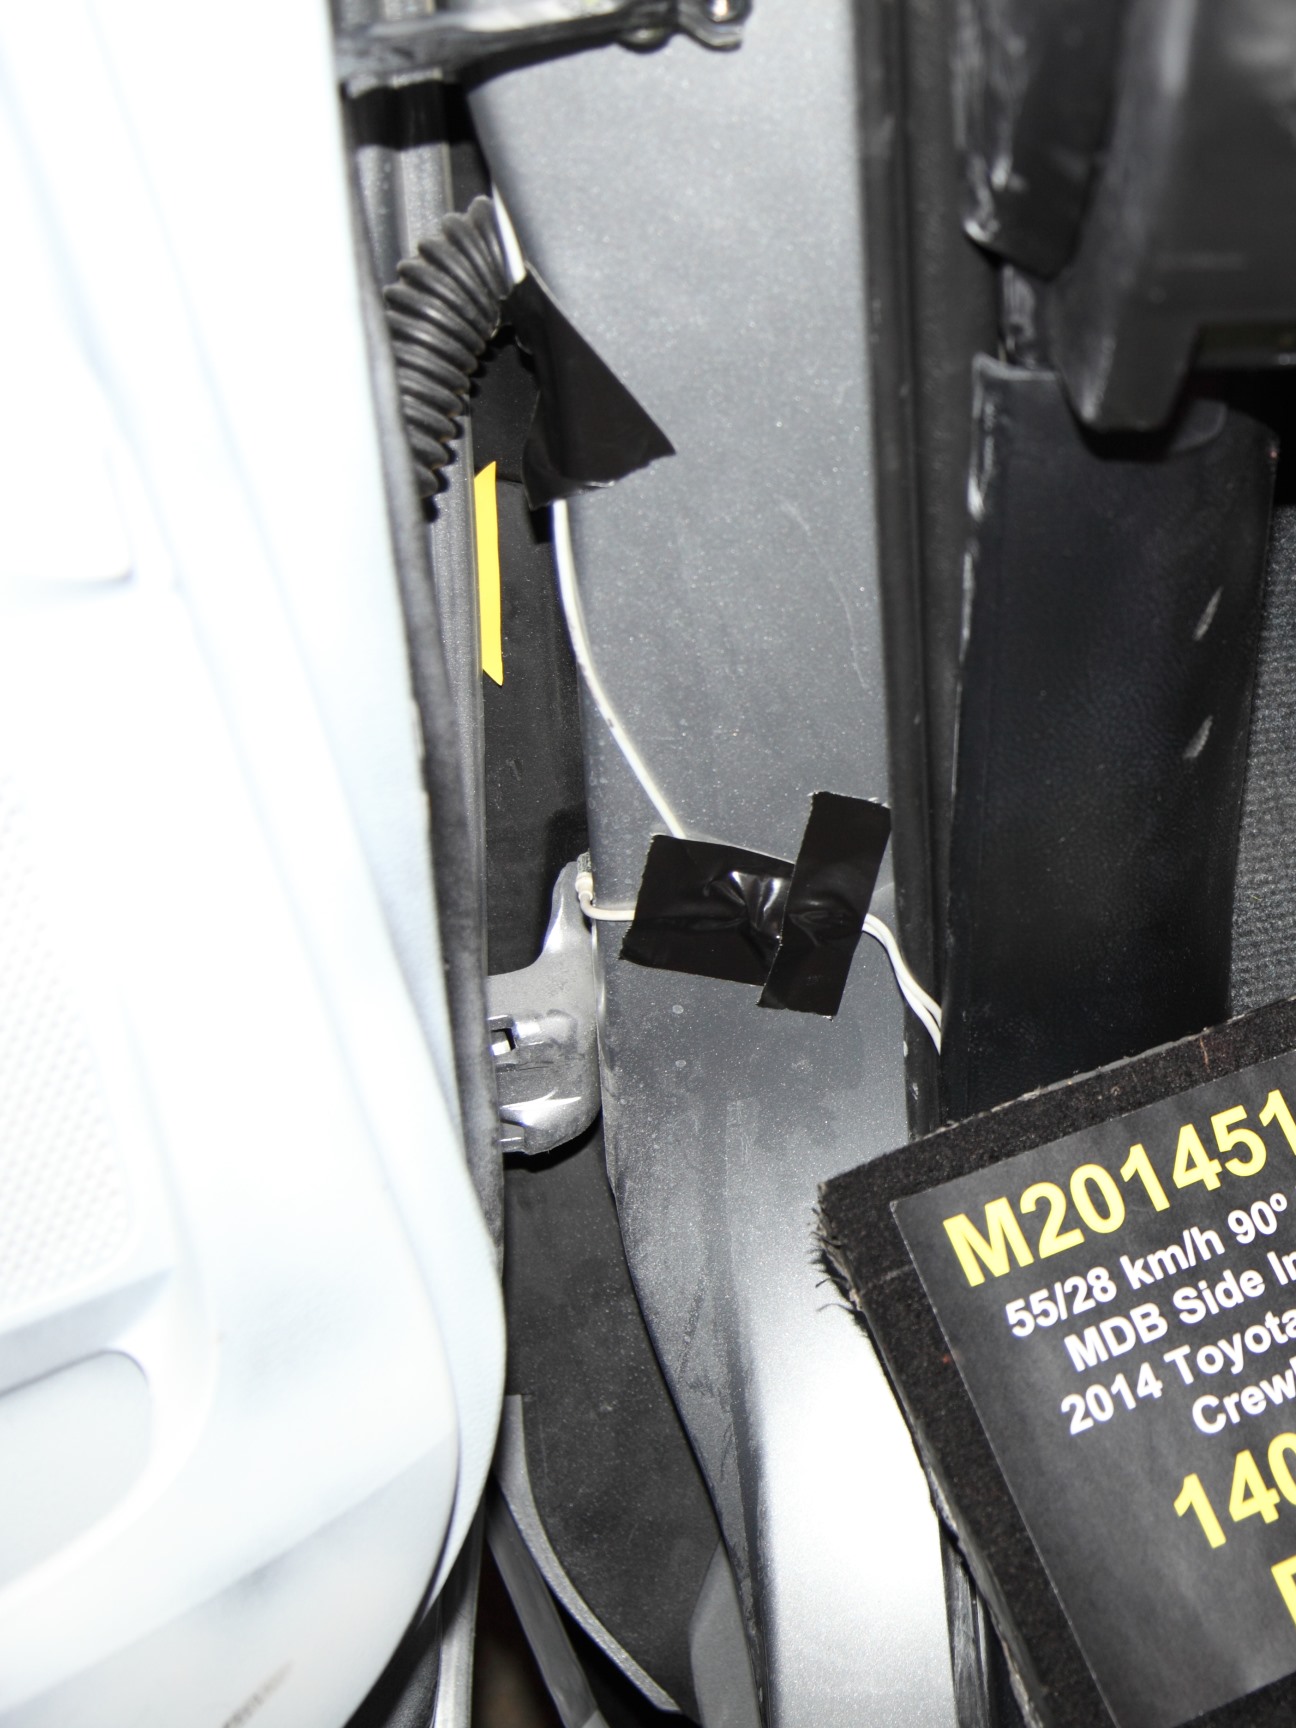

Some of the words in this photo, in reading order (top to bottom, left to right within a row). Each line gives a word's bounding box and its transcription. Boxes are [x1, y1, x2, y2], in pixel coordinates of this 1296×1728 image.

[1005, 1266, 1116, 1337] 55/28
[1119, 1226, 1225, 1290] km/h
[1064, 1303, 1169, 1372] MDB
[1172, 1264, 1265, 1325] Side
[1061, 1362, 1163, 1434] 2014
